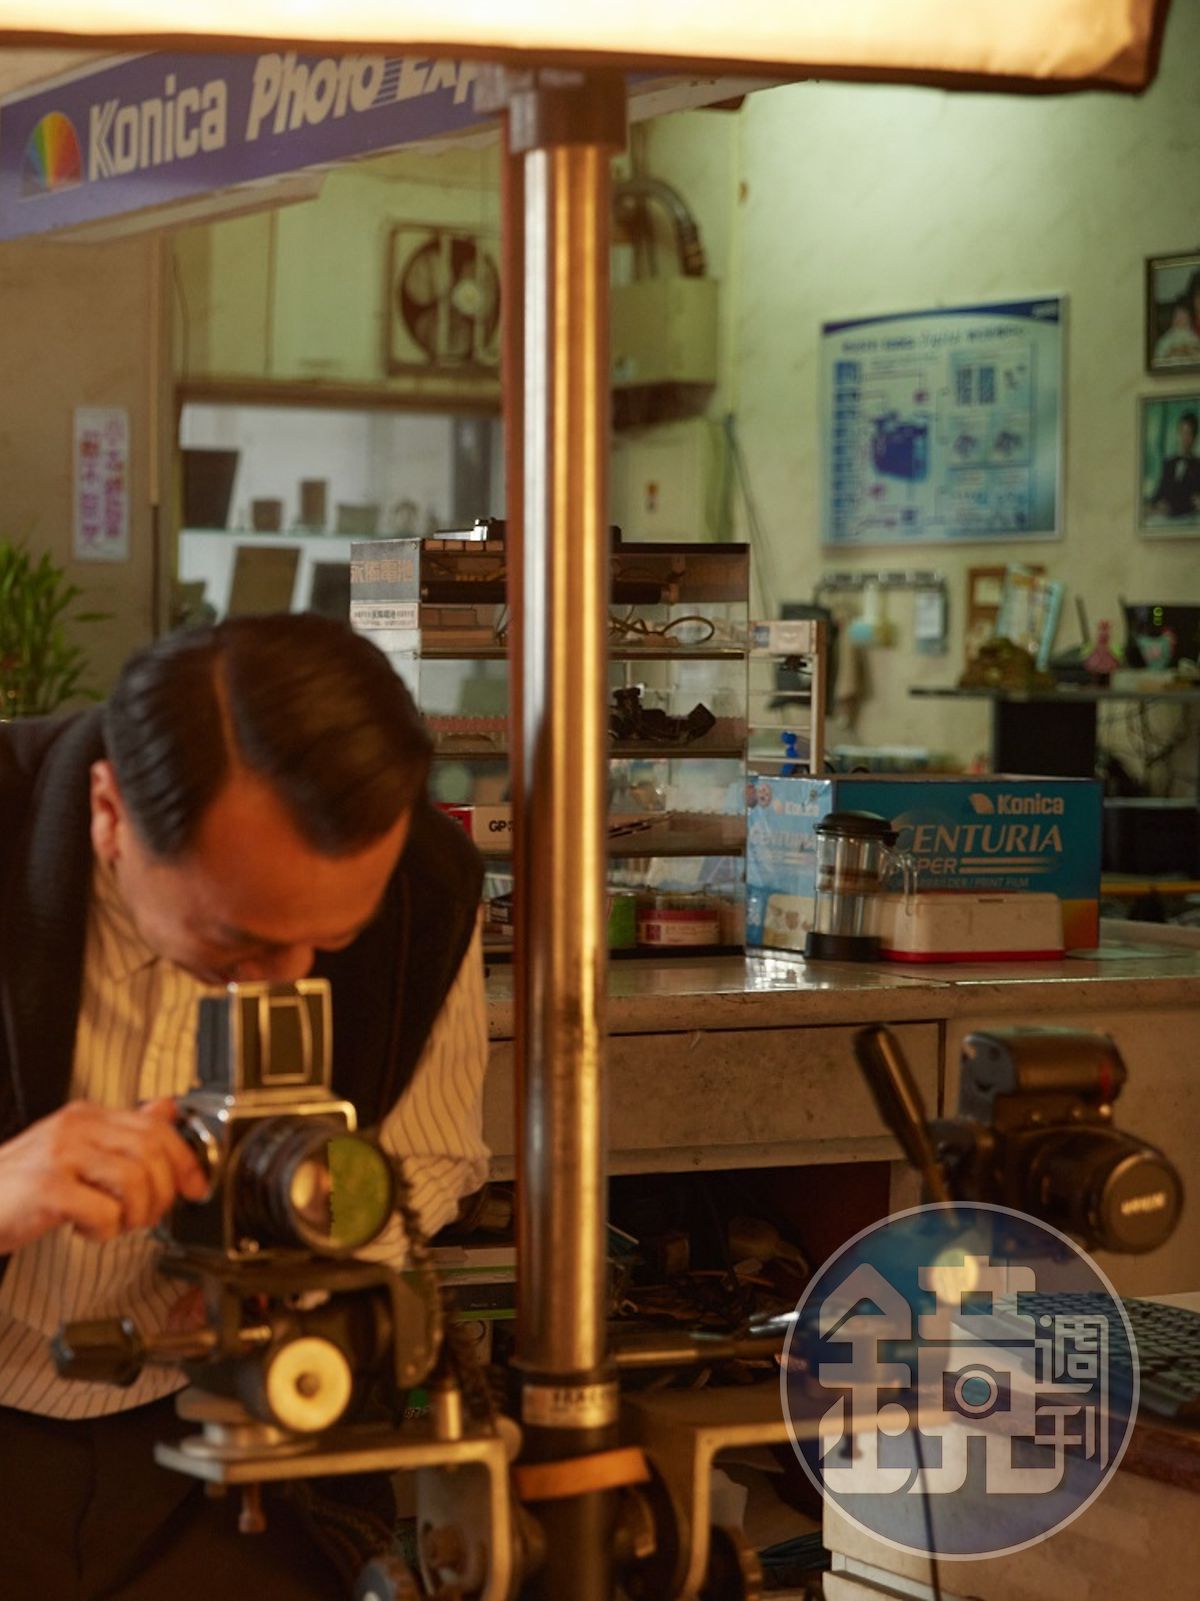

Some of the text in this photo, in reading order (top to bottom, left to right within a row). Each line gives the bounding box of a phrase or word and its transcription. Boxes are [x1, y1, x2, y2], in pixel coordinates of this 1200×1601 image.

[89, 74, 227, 181] Konica
[245, 51, 386, 142] Photo
[997, 793, 1065, 815] Konica
[891, 824, 1064, 853] CENTURIA
